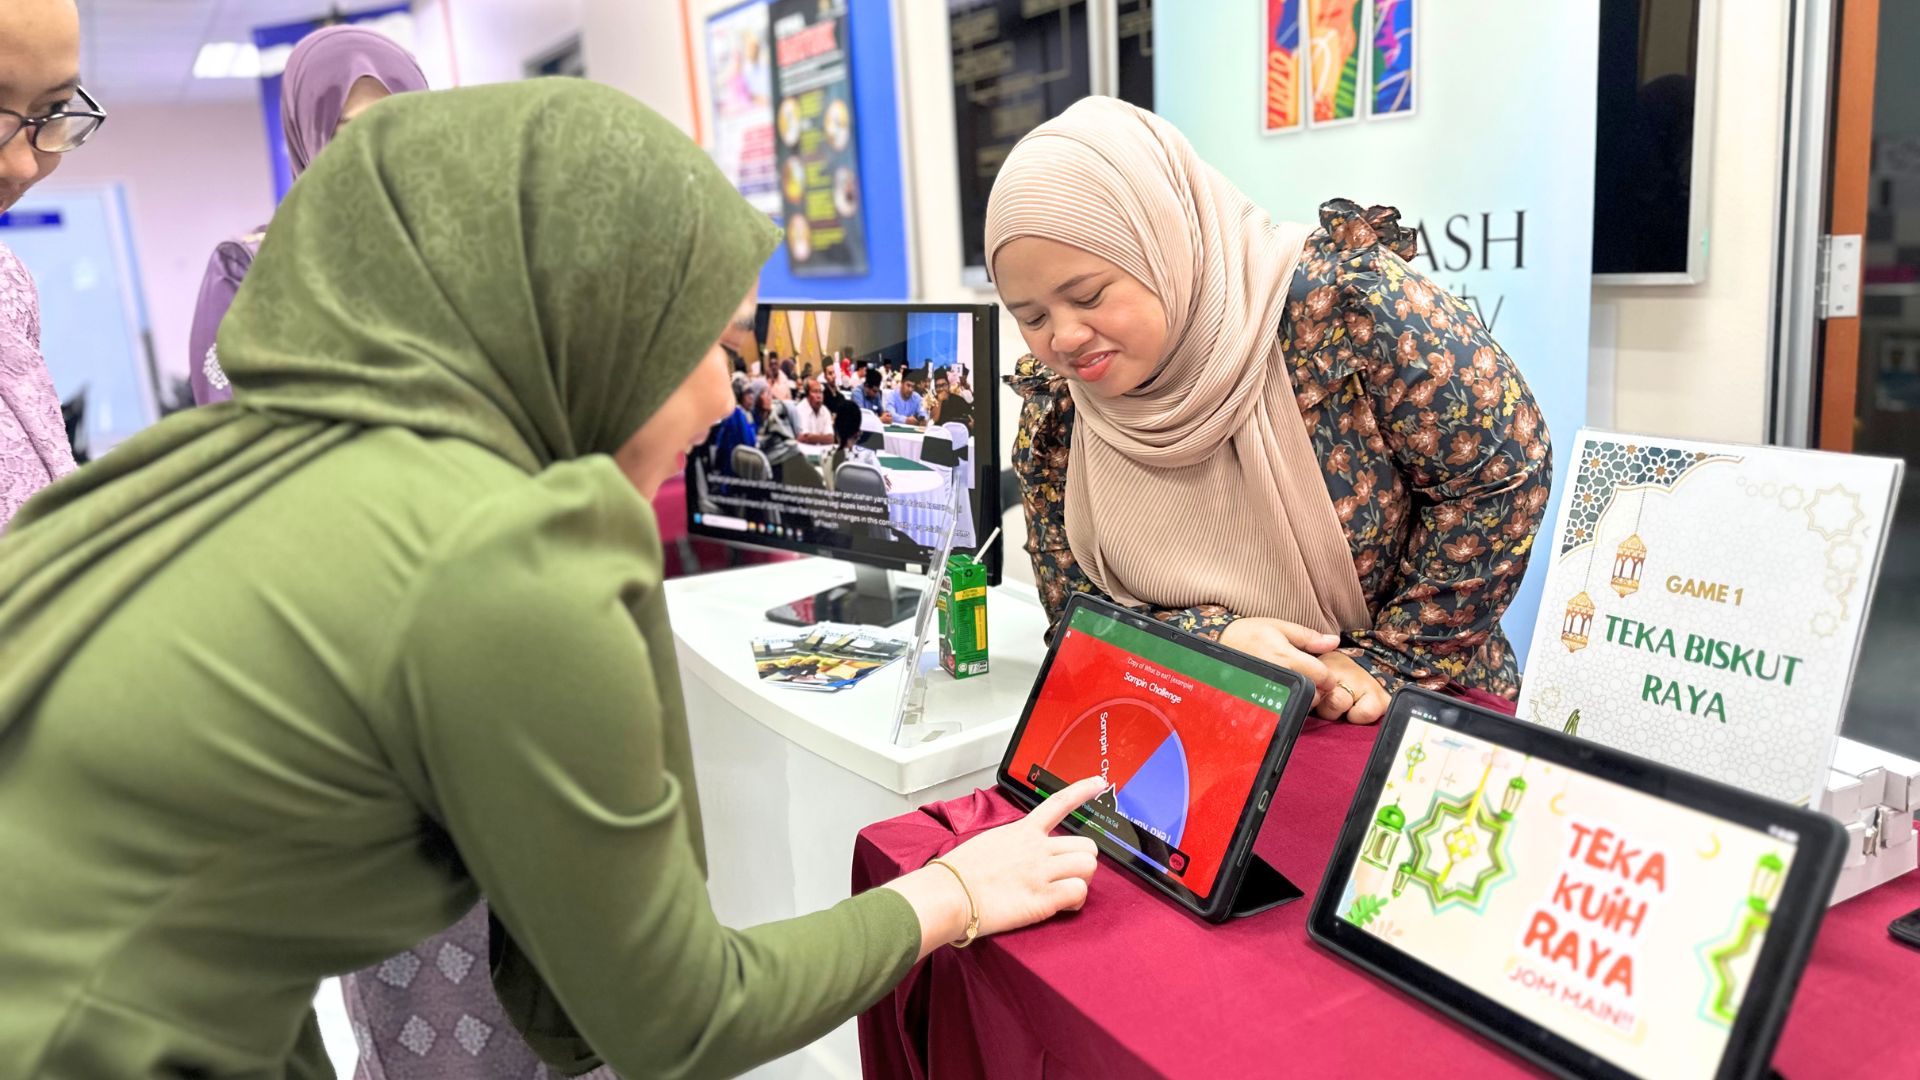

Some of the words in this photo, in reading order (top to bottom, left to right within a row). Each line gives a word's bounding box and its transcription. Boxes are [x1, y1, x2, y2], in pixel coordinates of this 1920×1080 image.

[1665, 575, 1729, 605] GAME
[1733, 587, 1744, 607] 1
[1605, 614, 1677, 659] TEKA
[1683, 633, 1804, 687] BISKUT
[1123, 671, 1148, 688] Sampin
[1148, 682, 1182, 704] Challenge
[1641, 673, 1728, 724] RAYA
[1098, 711, 1108, 756] Sampin
[1569, 821, 1666, 893] TEKA
[1523, 910, 1633, 997] RAYA
[1509, 965, 1557, 996] JOM
